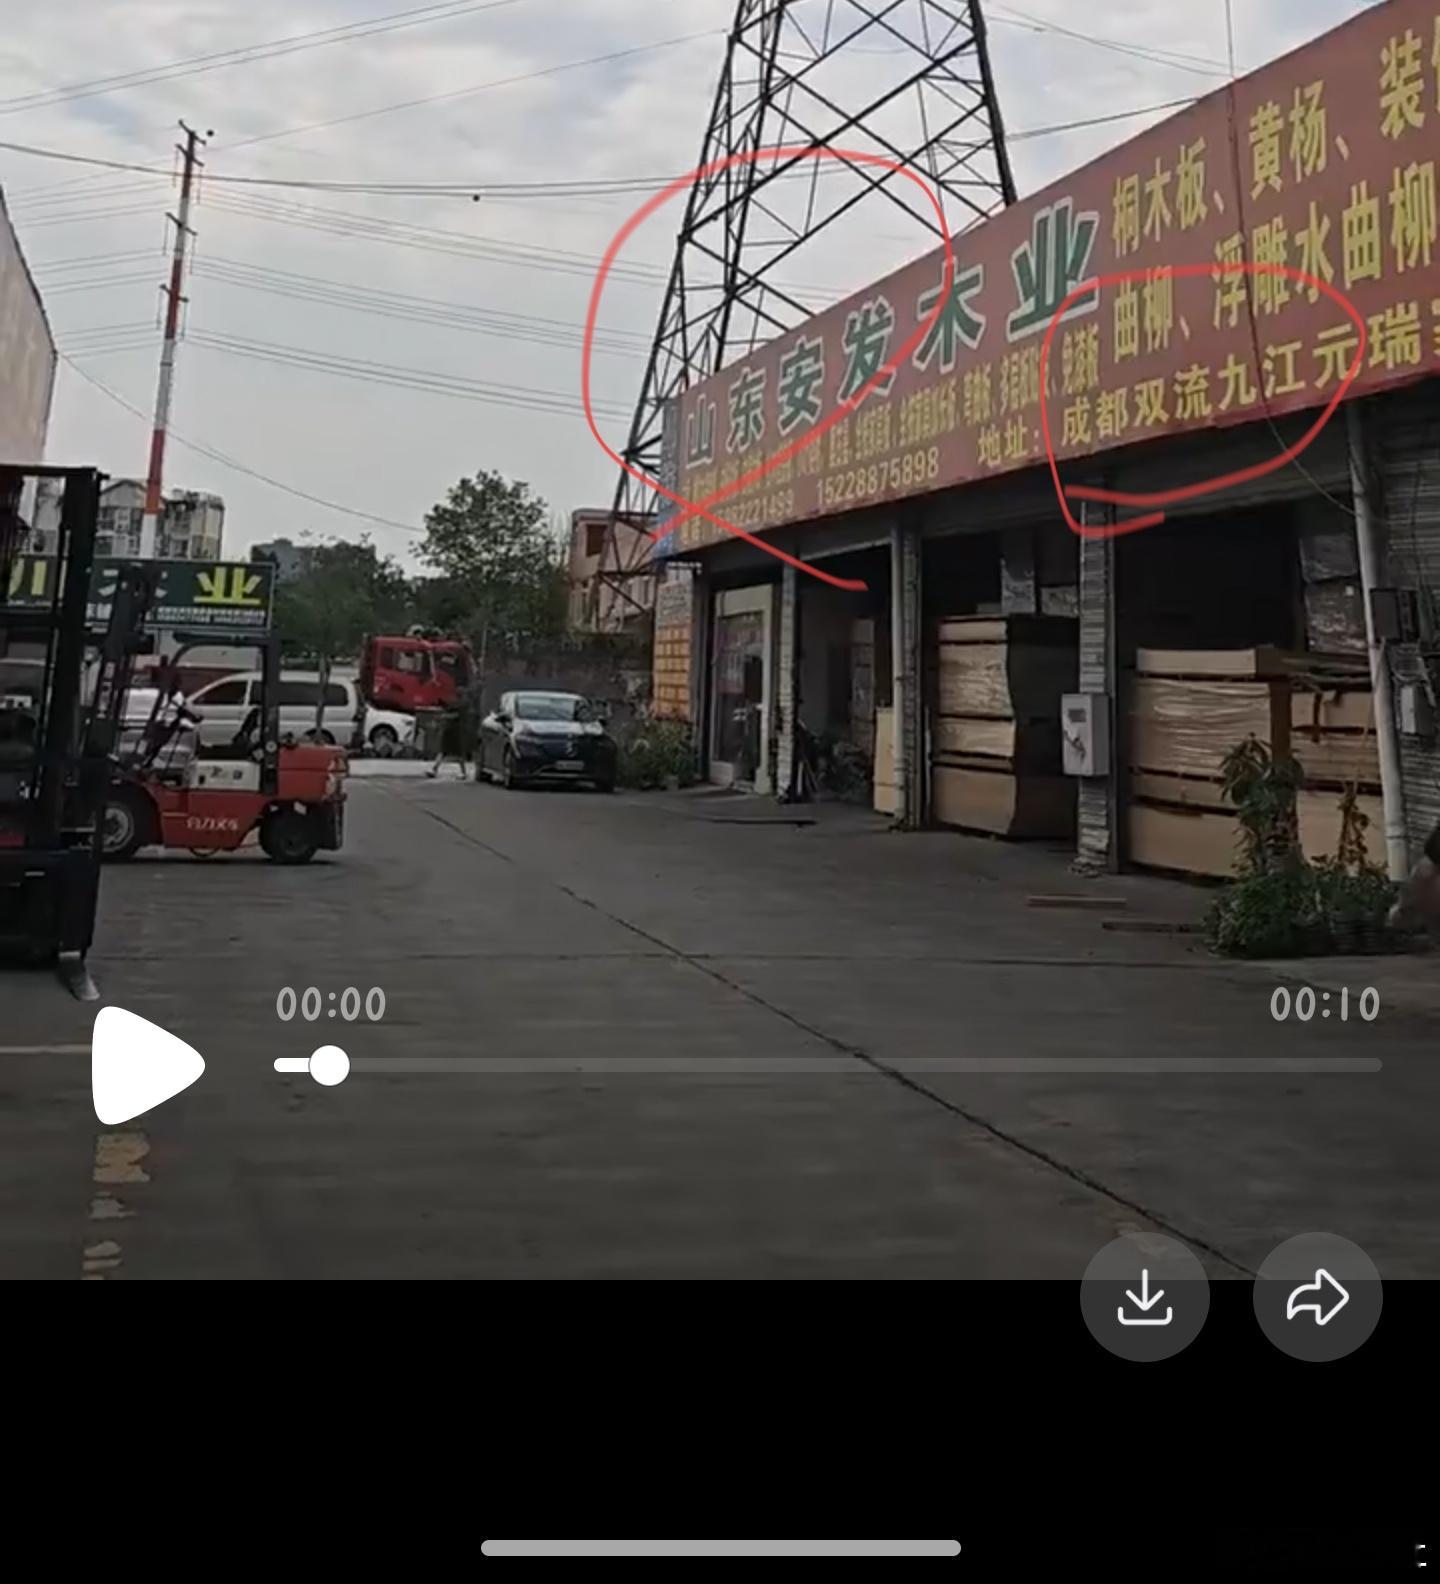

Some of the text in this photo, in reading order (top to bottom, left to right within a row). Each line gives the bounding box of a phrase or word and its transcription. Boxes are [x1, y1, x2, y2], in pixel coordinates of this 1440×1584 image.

[1112, 16, 1440, 258] 桐木板、黄杨、装
